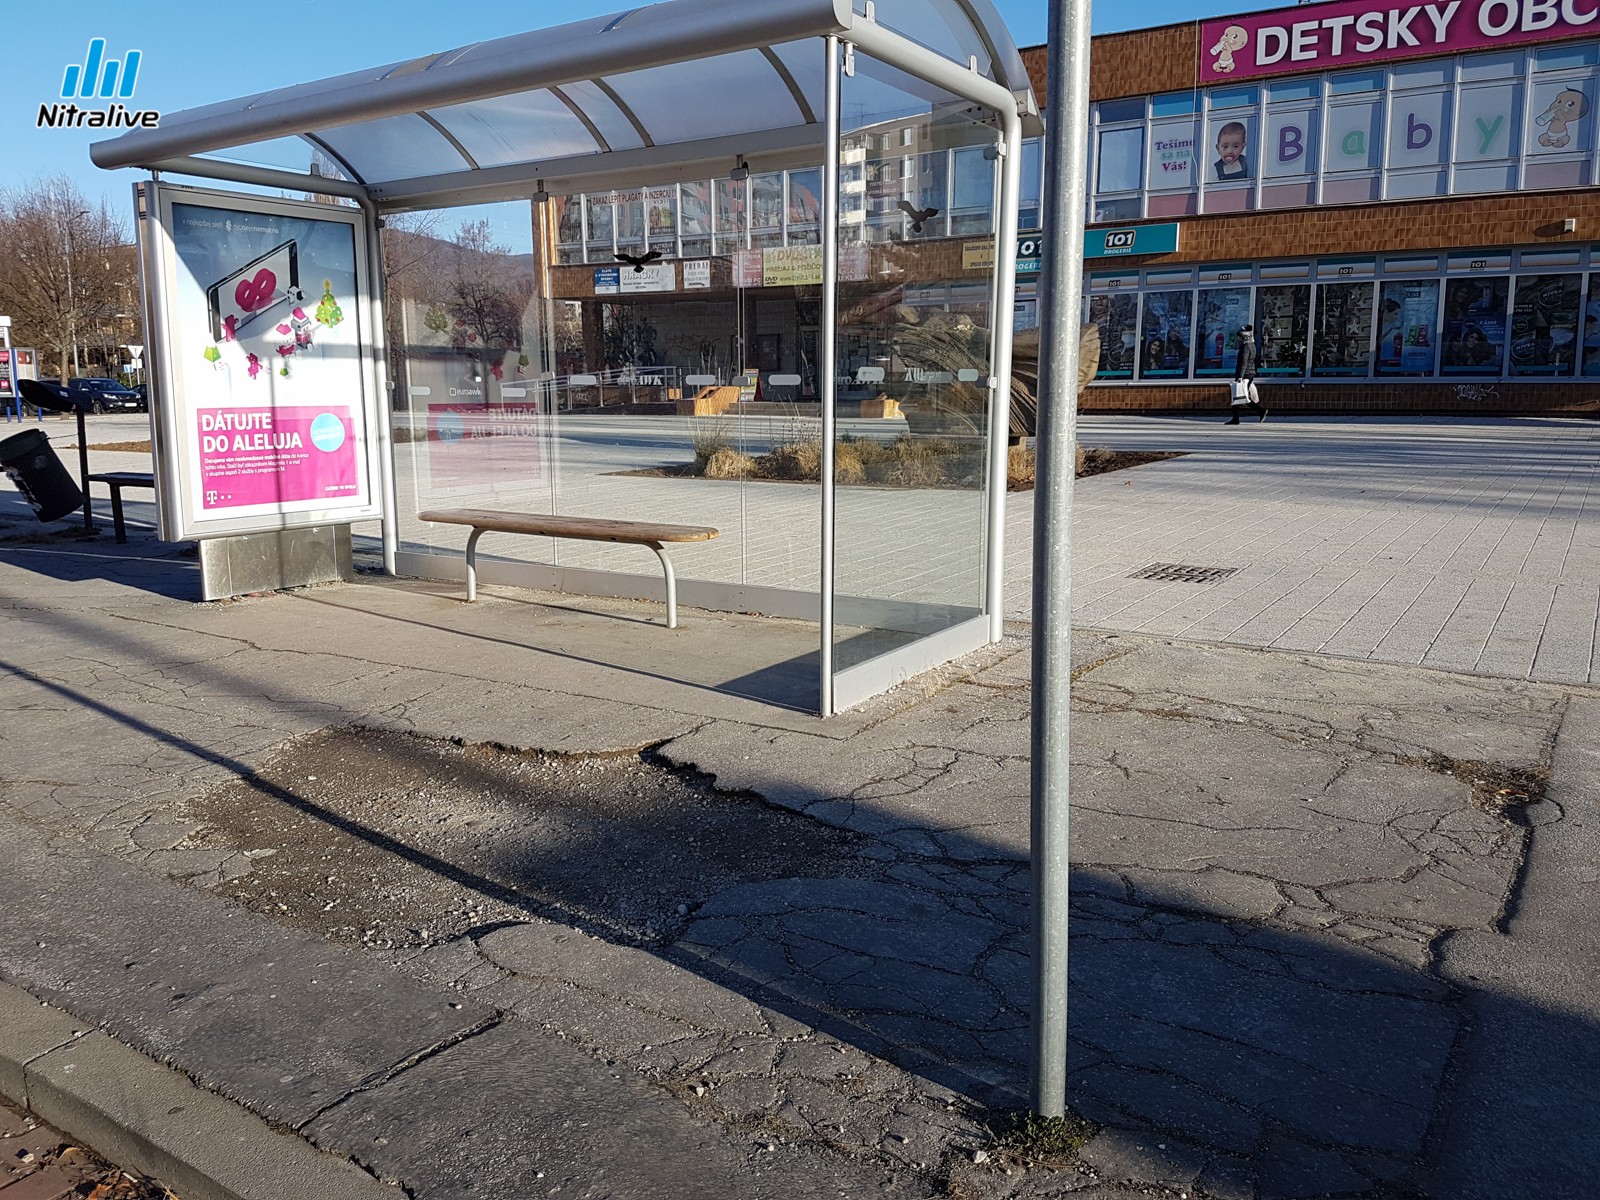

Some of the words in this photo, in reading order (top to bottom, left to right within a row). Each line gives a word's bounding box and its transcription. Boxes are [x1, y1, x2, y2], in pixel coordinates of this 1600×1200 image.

[1162, 161, 1187, 172] Vás!
[1106, 232, 1134, 246] 101
[201, 410, 272, 432] DÁTUJTE
[203, 435, 229, 453] DO
[232, 432, 303, 452] ALELUJA
